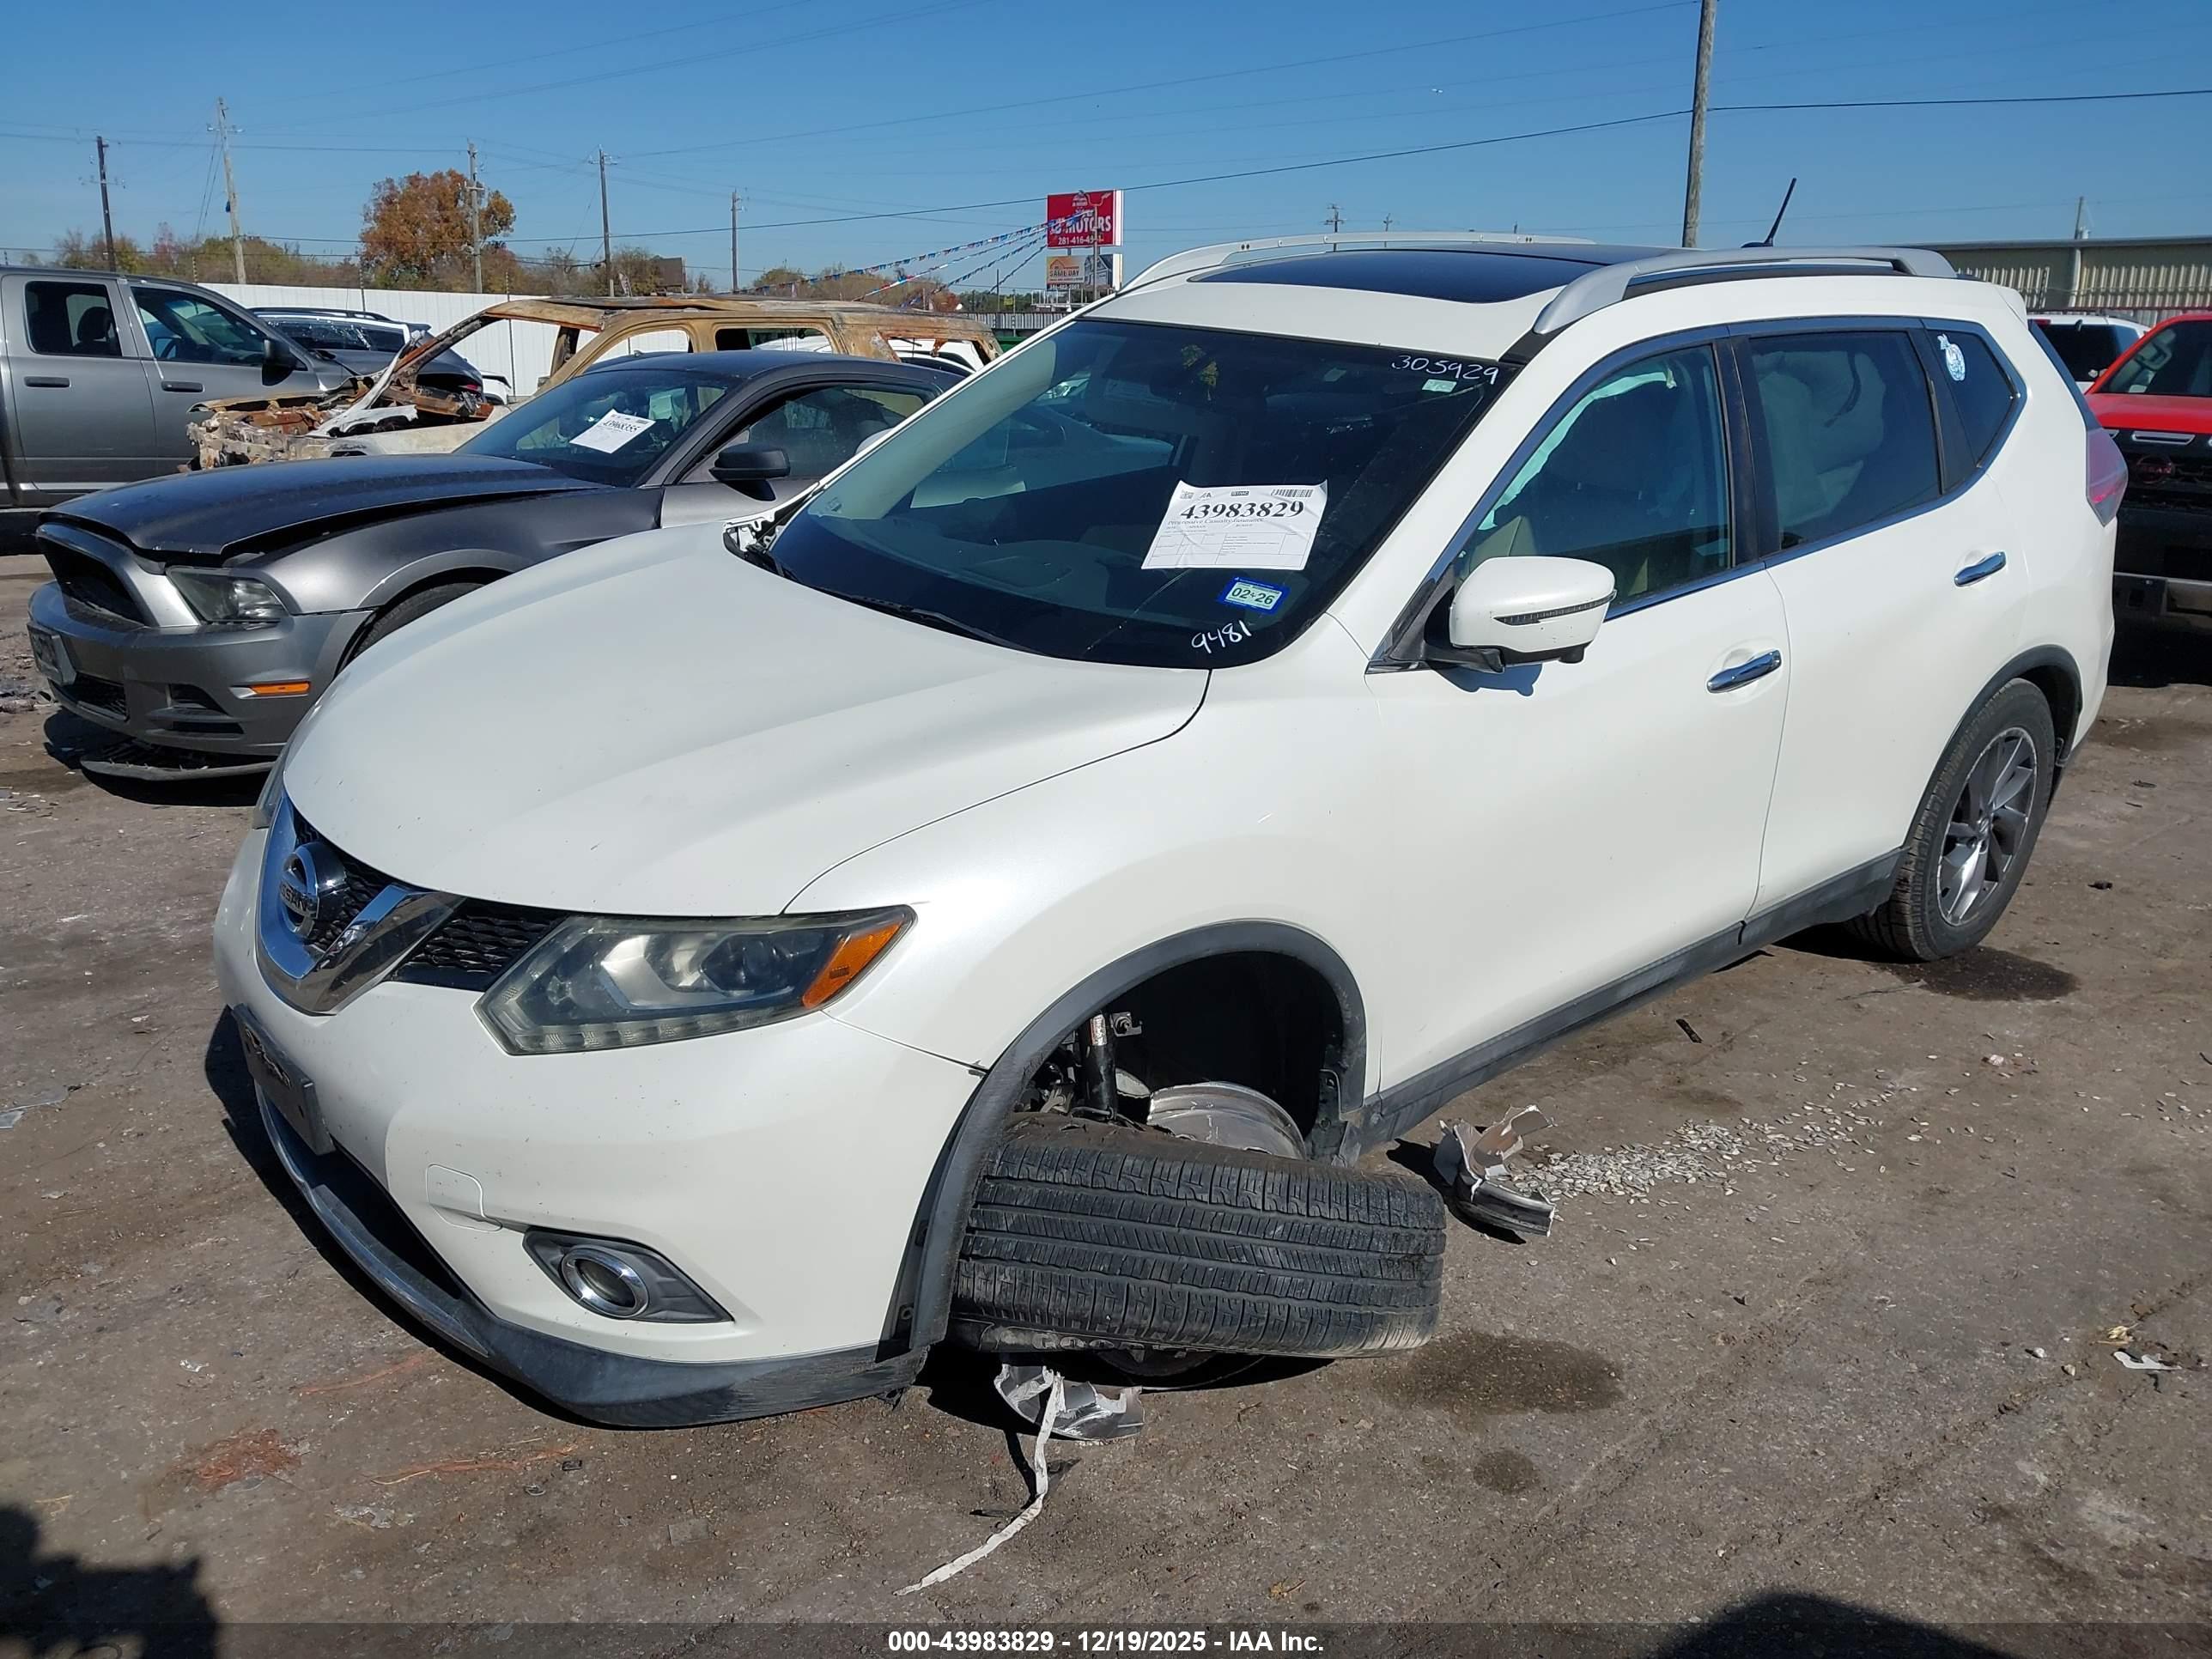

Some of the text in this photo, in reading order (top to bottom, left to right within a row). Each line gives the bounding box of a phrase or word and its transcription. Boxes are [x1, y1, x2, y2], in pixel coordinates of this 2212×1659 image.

[1391, 355, 1499, 386] 305929
[1180, 500, 1304, 520] 43983829
[1191, 619, 1252, 654] 9481
